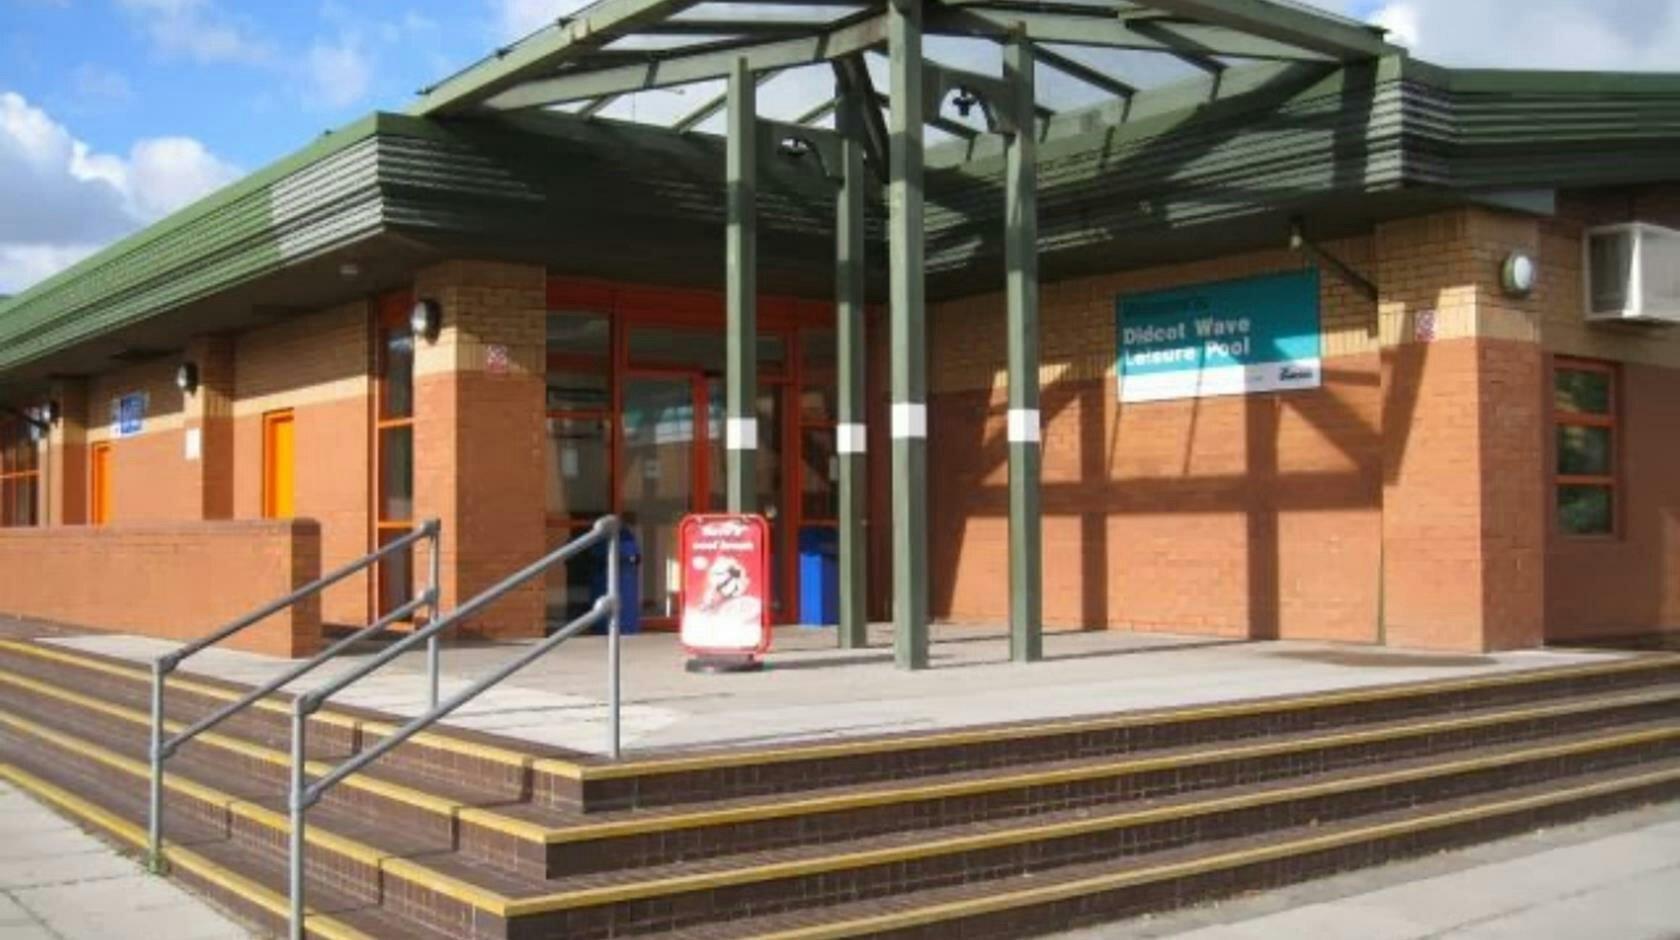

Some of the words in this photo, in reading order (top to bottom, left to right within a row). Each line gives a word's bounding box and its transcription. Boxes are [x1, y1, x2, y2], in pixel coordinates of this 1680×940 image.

[1123, 322, 1186, 345] Didcot
[1194, 316, 1251, 338] Wave
[1124, 346, 1195, 365] Leisure
[1204, 337, 1250, 357] Pool
